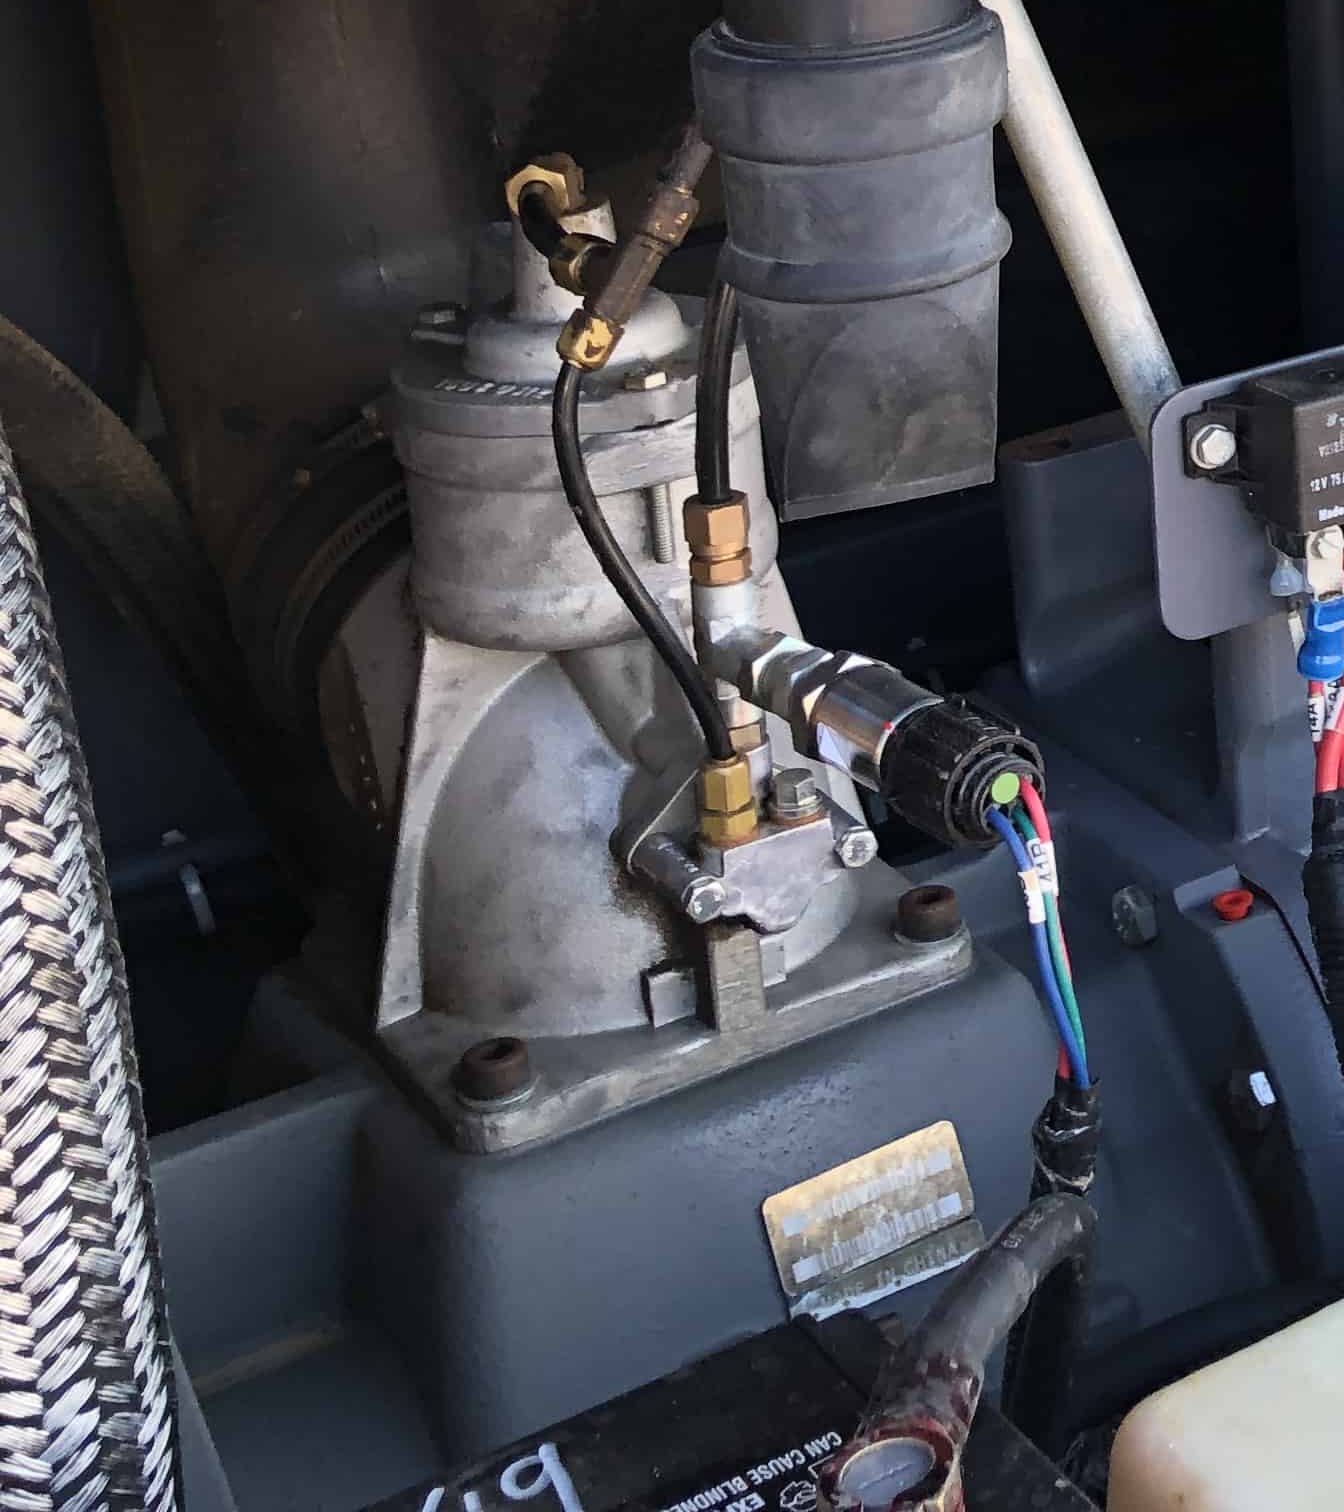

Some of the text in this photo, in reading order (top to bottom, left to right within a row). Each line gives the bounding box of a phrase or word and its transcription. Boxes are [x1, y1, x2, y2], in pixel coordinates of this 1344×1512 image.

[1318, 504, 1344, 522] Made
[804, 1431, 843, 1459] CAN
[746, 1448, 807, 1486] CAUSE
